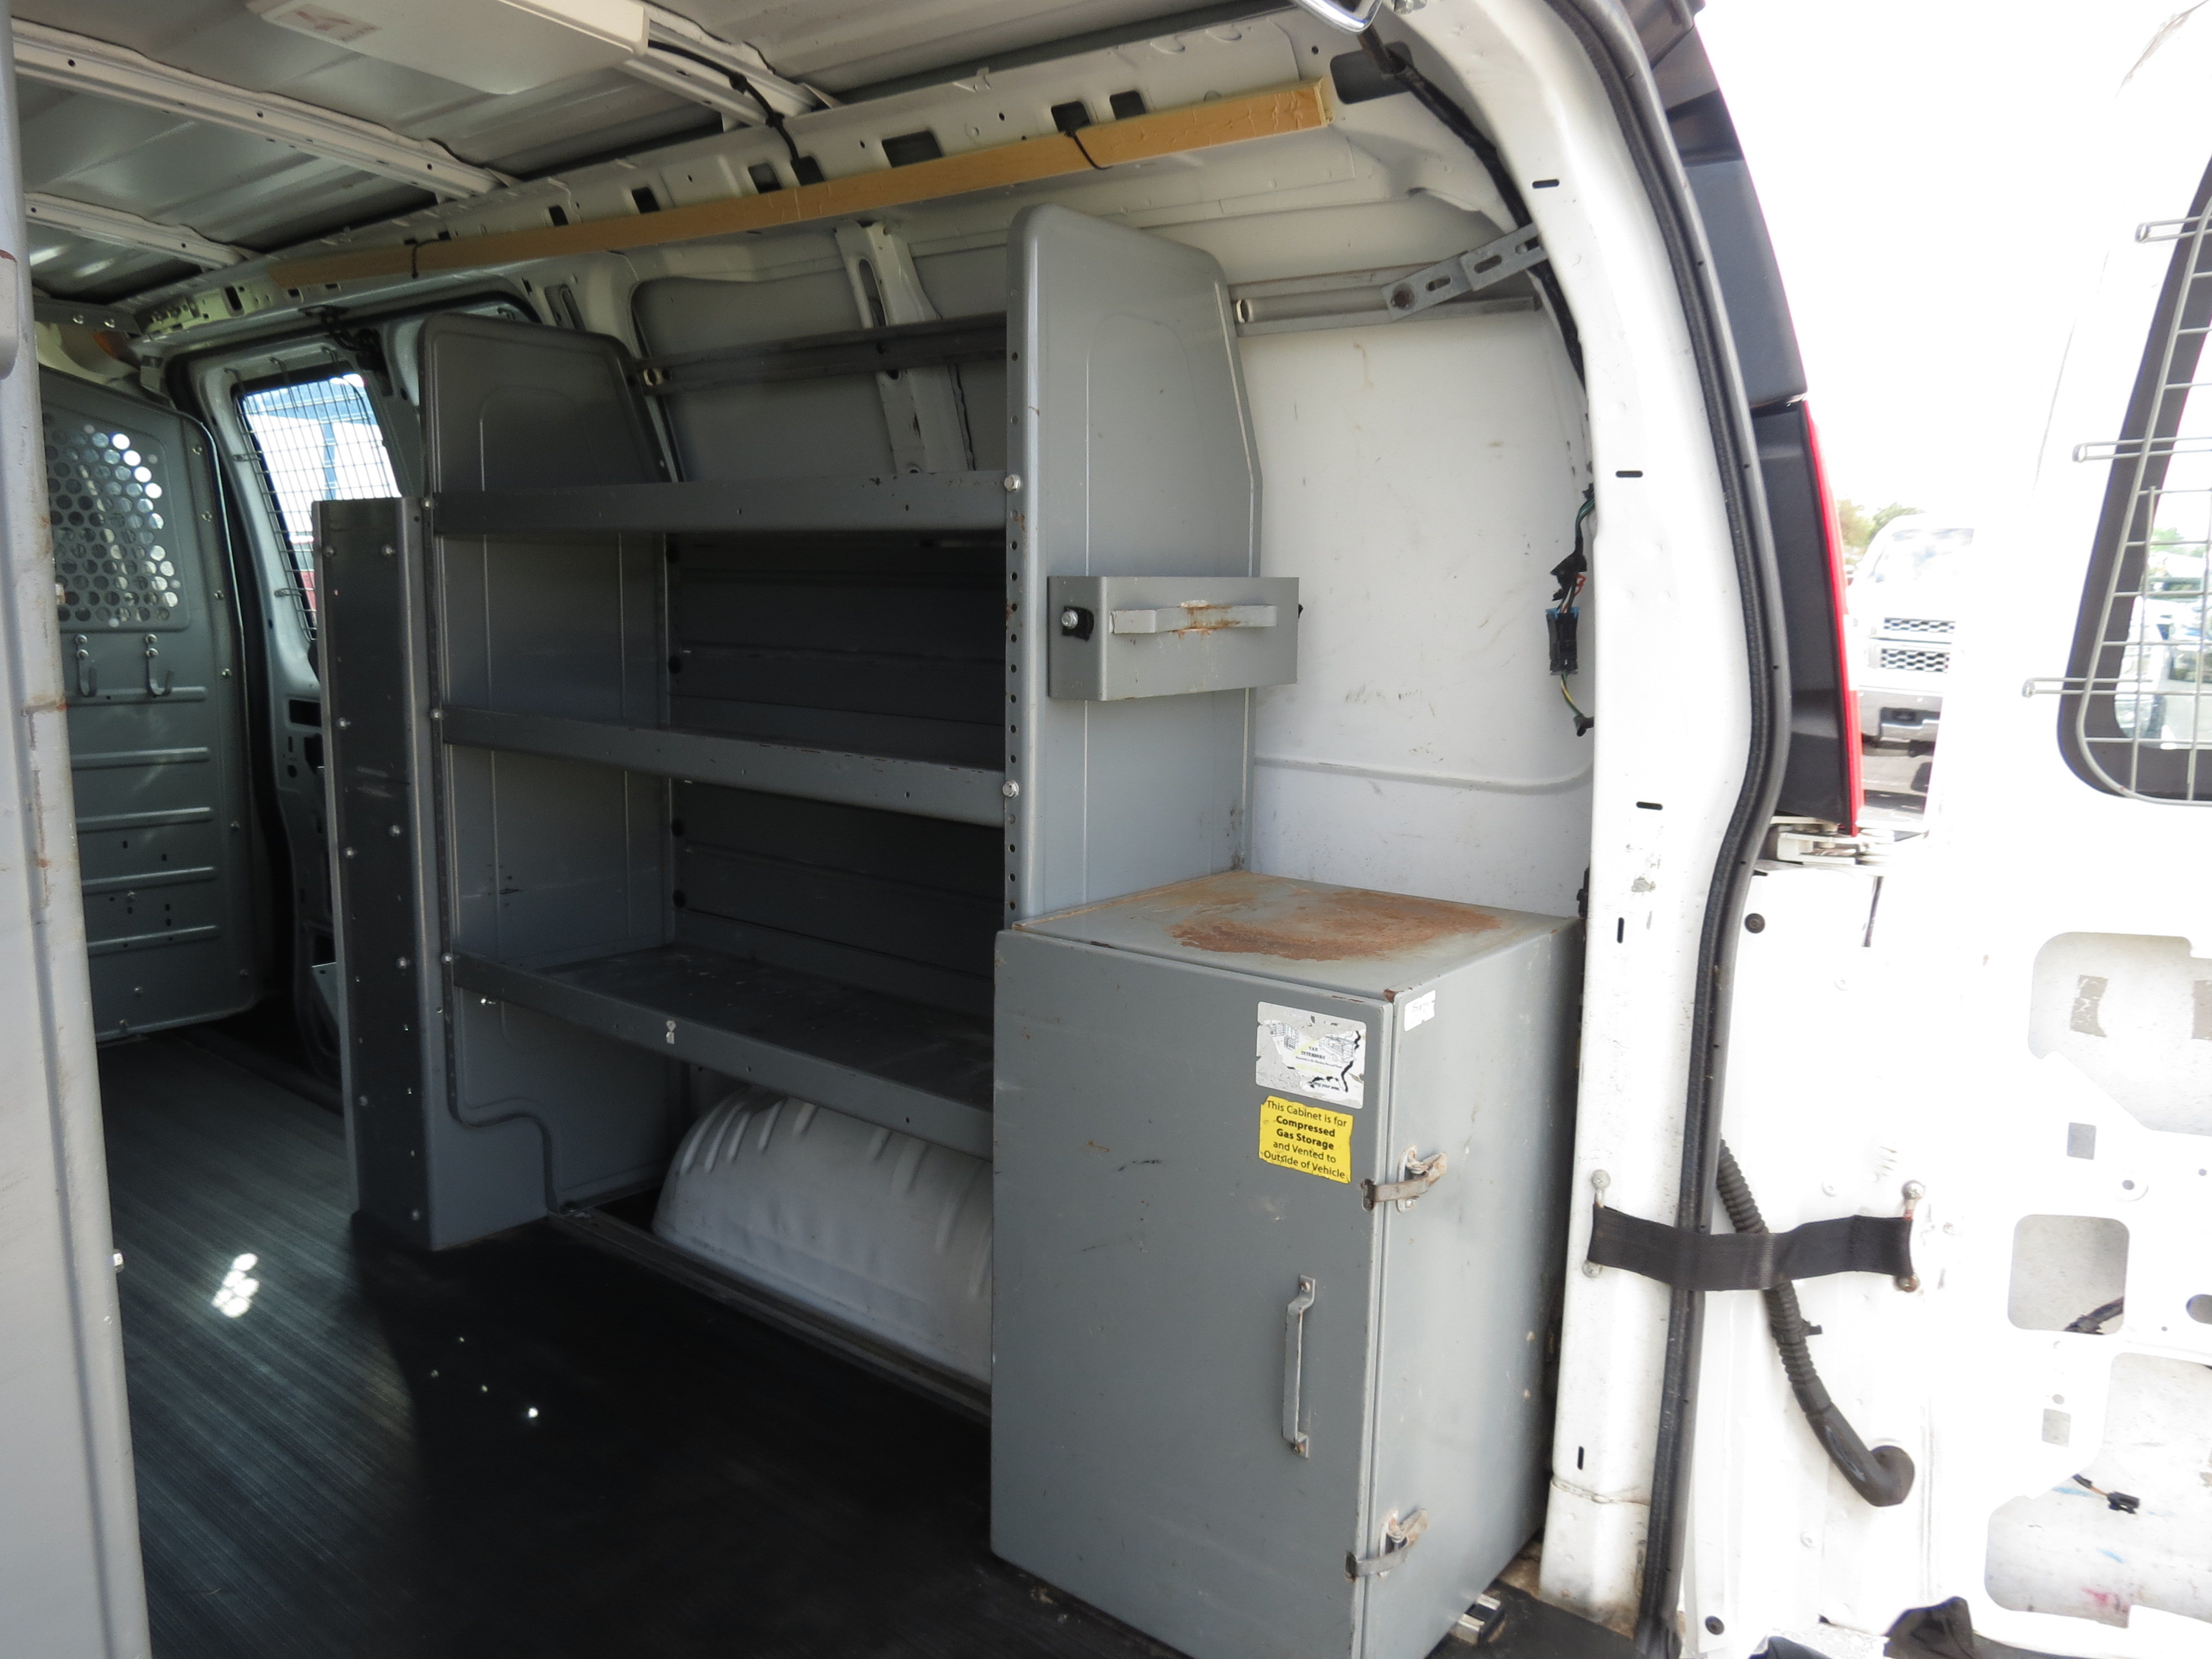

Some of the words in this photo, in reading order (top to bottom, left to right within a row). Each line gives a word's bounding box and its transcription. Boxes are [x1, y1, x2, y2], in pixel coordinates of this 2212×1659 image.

[1267, 1100, 1284, 1112] This
[1287, 1105, 1322, 1121] Cabinet
[1324, 1114, 1331, 1123] is
[1334, 1116, 1347, 1126] for
[1276, 1115, 1335, 1137] Compressed
[1276, 1128, 1294, 1140] Gas
[1296, 1133, 1334, 1150] Storage
[1273, 1141, 1290, 1151] and
[1292, 1144, 1324, 1160] Vented
[1327, 1154, 1336, 1163] to
[1264, 1150, 1298, 1166] Outside
[1301, 1161, 1310, 1169] of
[1312, 1162, 1345, 1178] Vehicle
